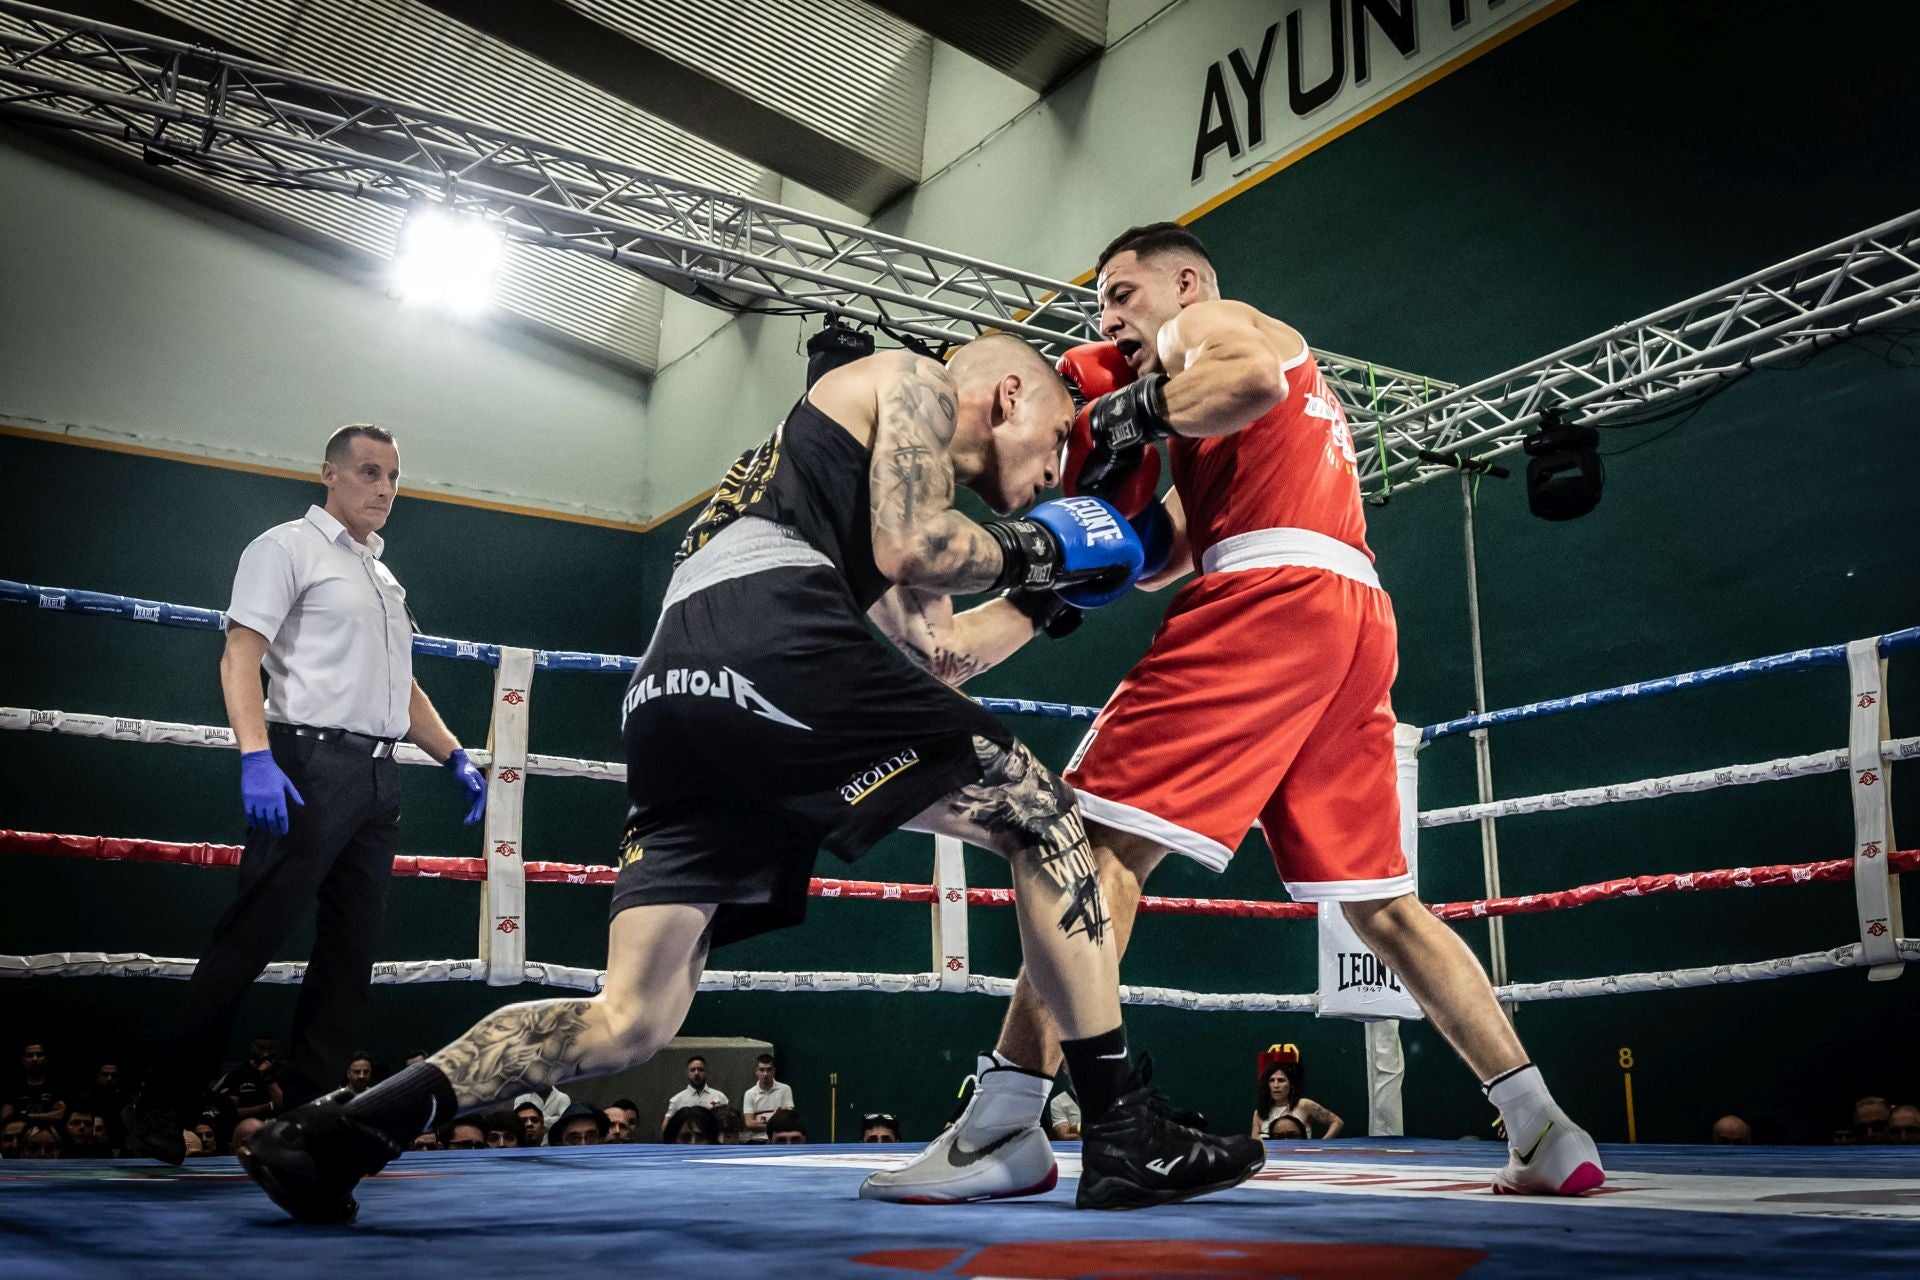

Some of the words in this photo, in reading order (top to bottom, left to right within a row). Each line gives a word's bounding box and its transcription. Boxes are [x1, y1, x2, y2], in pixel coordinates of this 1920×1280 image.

[1191, 0, 1503, 185] AYUN
[1050, 499, 1123, 547] LEONE
[666, 666, 813, 731] RIOJA
[840, 748, 919, 802] aroma
[1619, 1047, 1633, 1069] 8
